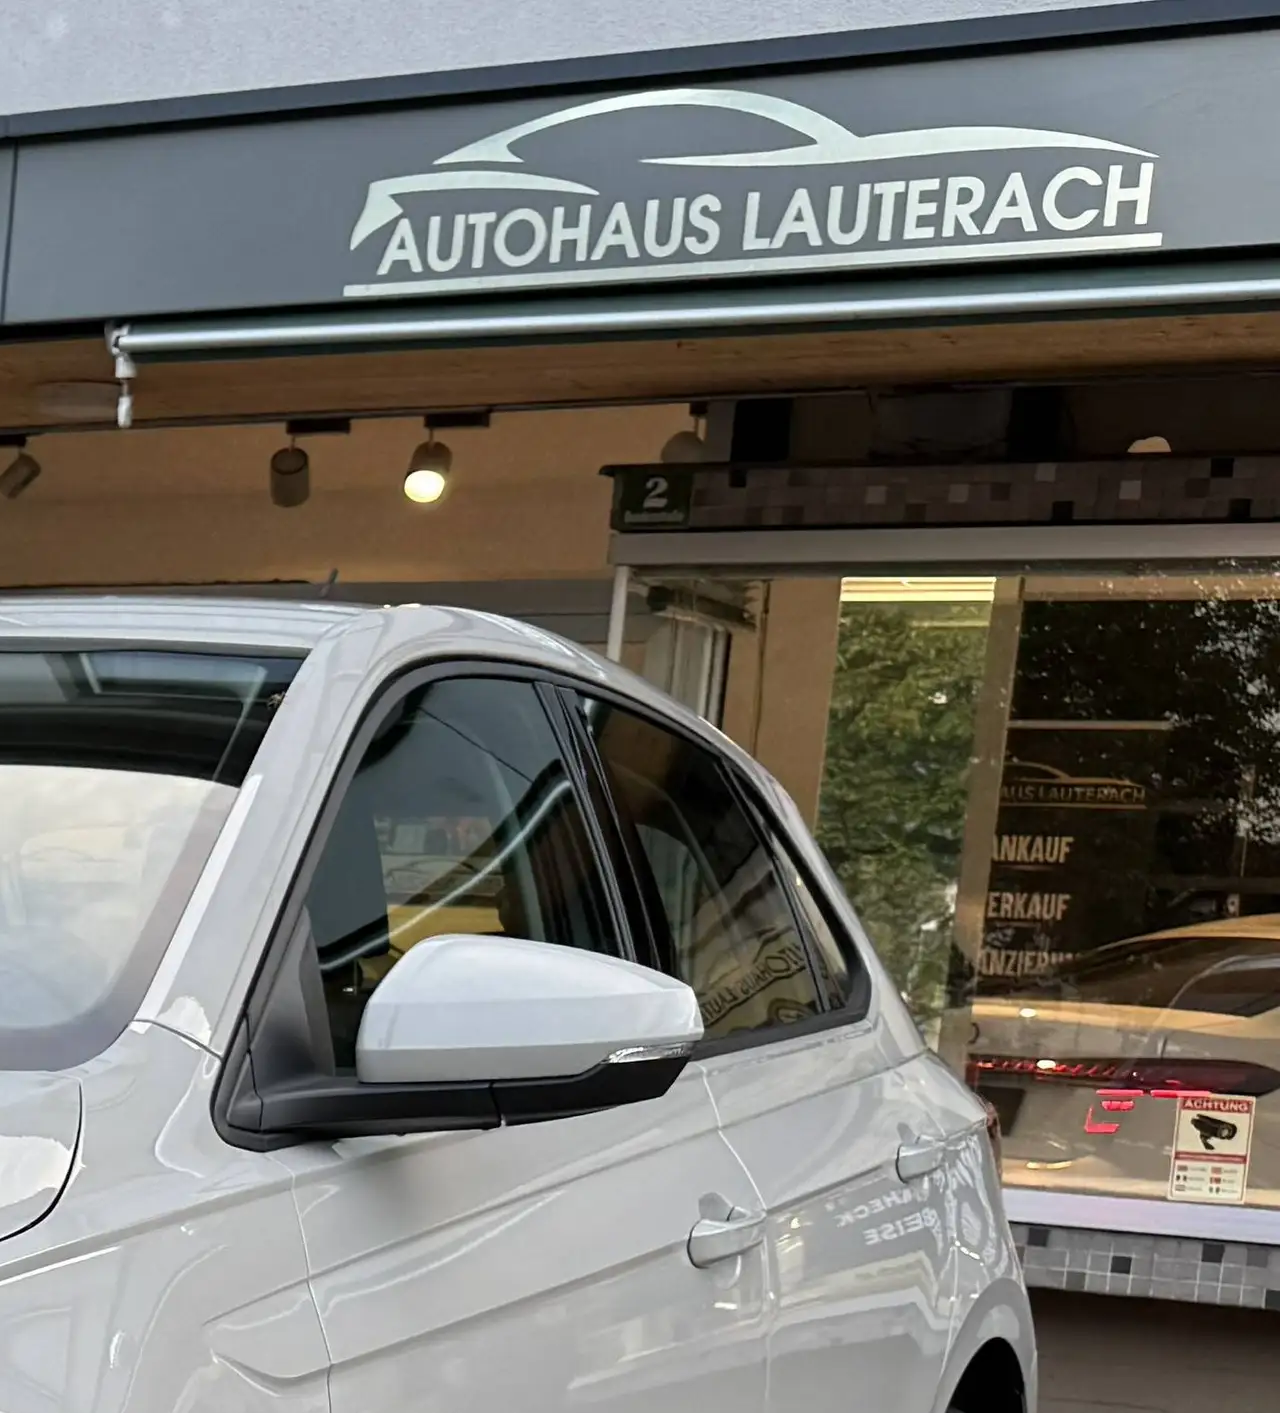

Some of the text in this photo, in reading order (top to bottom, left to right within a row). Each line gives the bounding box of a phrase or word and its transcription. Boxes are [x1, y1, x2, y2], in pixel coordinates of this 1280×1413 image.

[377, 161, 1156, 277] AUTOHAUS LAUTERACH
[643, 476, 669, 509] 2
[1038, 785, 1147, 802] LAUTERACH
[1185, 1099, 1248, 1111] ACHTUNG
